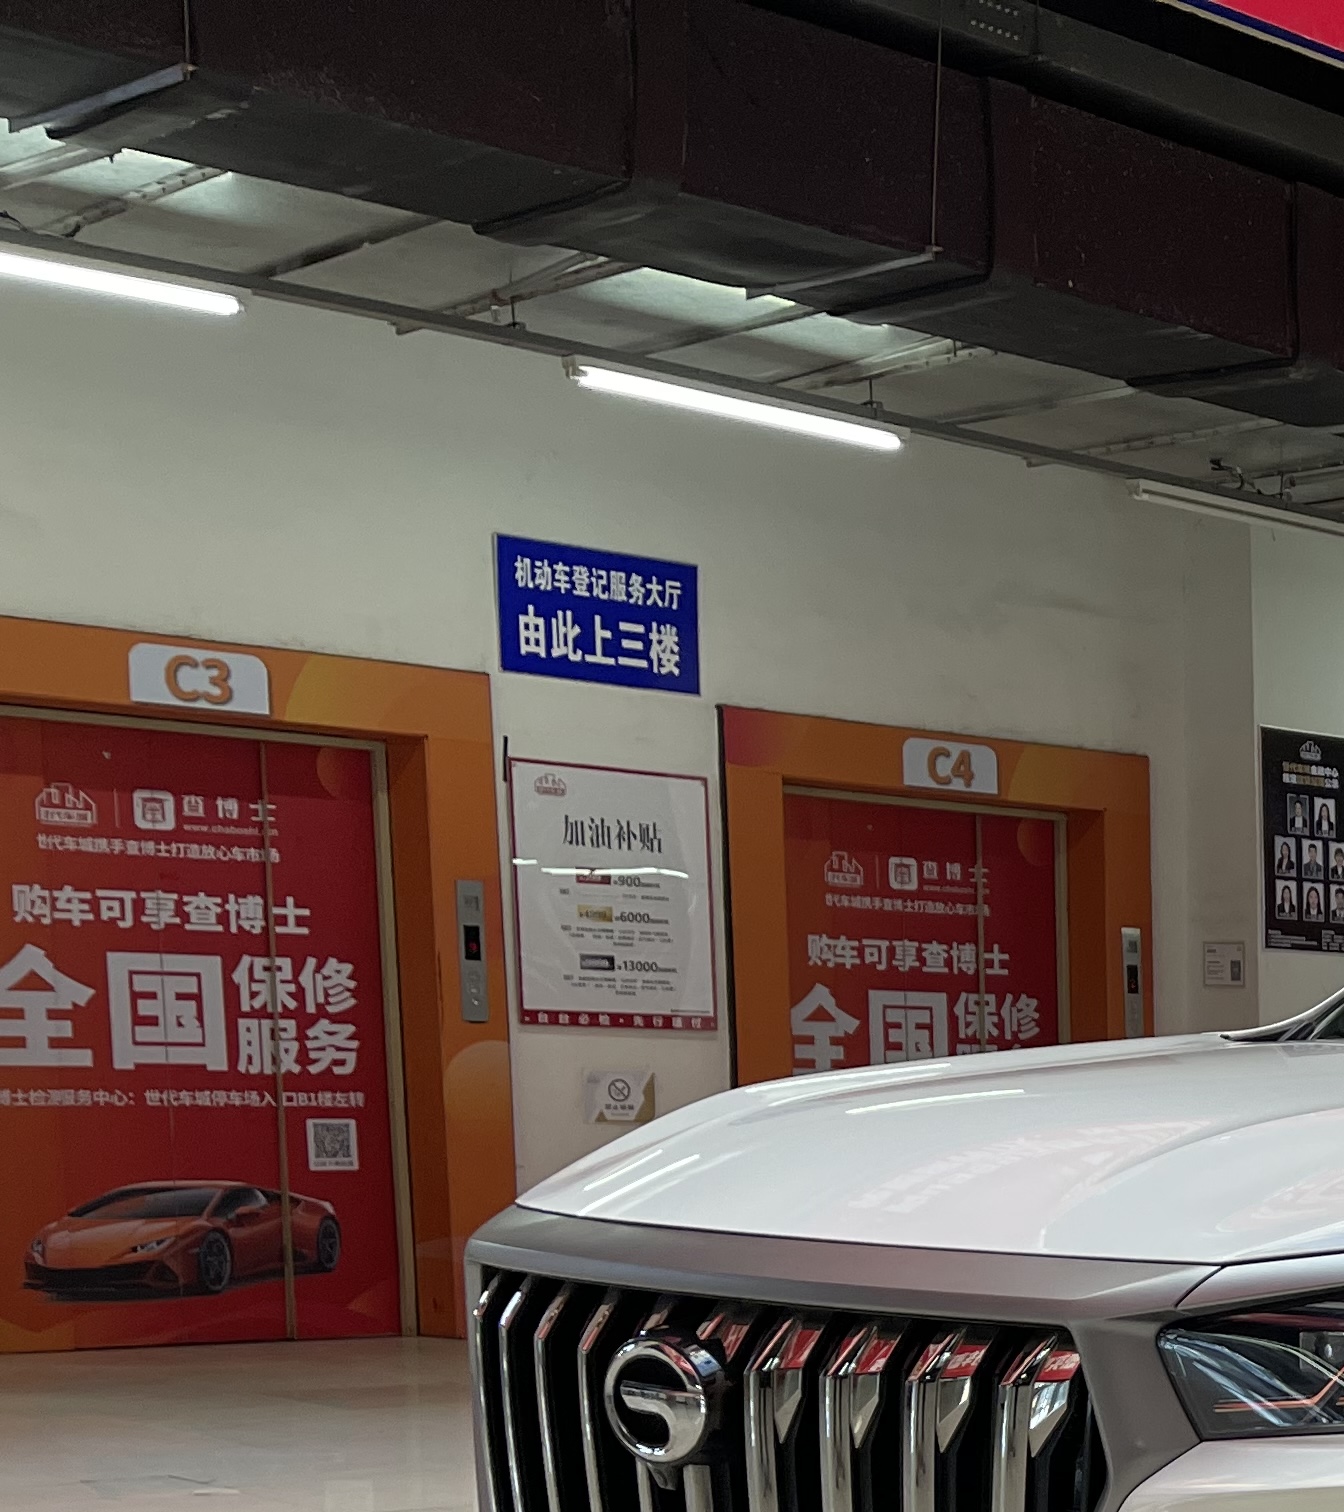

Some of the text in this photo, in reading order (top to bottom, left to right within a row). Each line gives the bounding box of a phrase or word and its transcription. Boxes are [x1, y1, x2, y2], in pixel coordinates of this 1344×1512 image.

[514, 555, 682, 610] 机动车登记服务大厅
[519, 604, 681, 677] 由此上三楼
[164, 654, 233, 704] C3
[927, 746, 975, 788] C4
[562, 814, 663, 853] 加油补贴
[12, 882, 312, 936] 购车可享查博士
[807, 934, 1011, 976] 购车可享查博士
[0, 944, 229, 1072] 全国
[232, 953, 359, 1014] 保修
[237, 1018, 361, 1076] 服务
